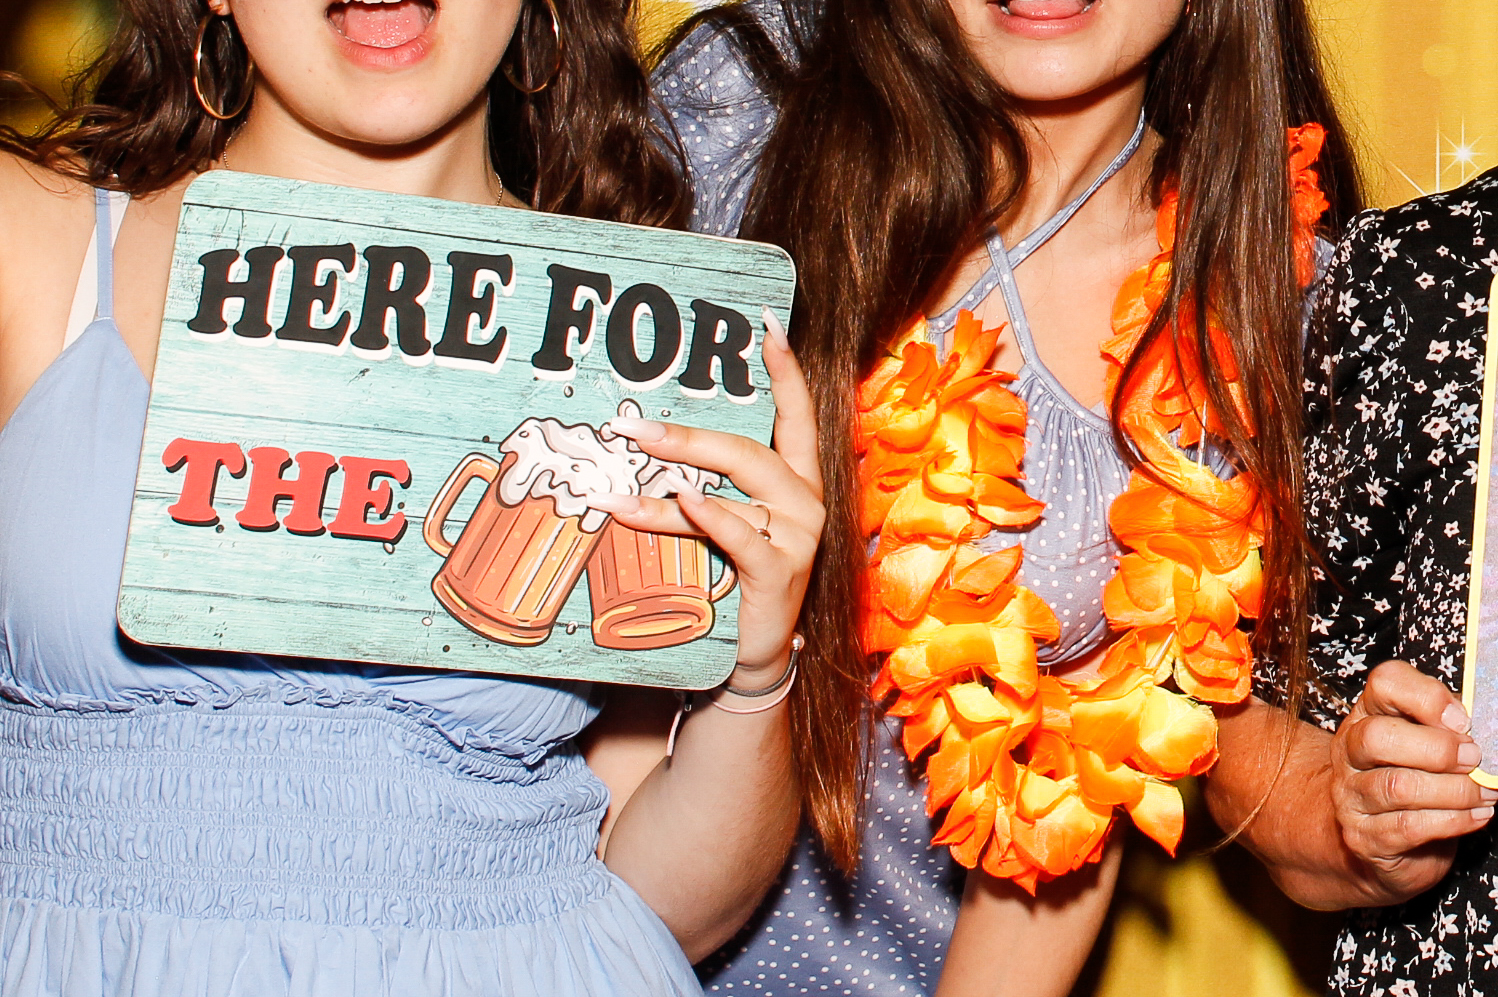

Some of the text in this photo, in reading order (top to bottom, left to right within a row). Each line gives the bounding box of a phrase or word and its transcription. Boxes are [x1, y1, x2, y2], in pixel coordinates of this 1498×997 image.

[187, 242, 759, 404] HERE FOR
[161, 437, 412, 543] THE
